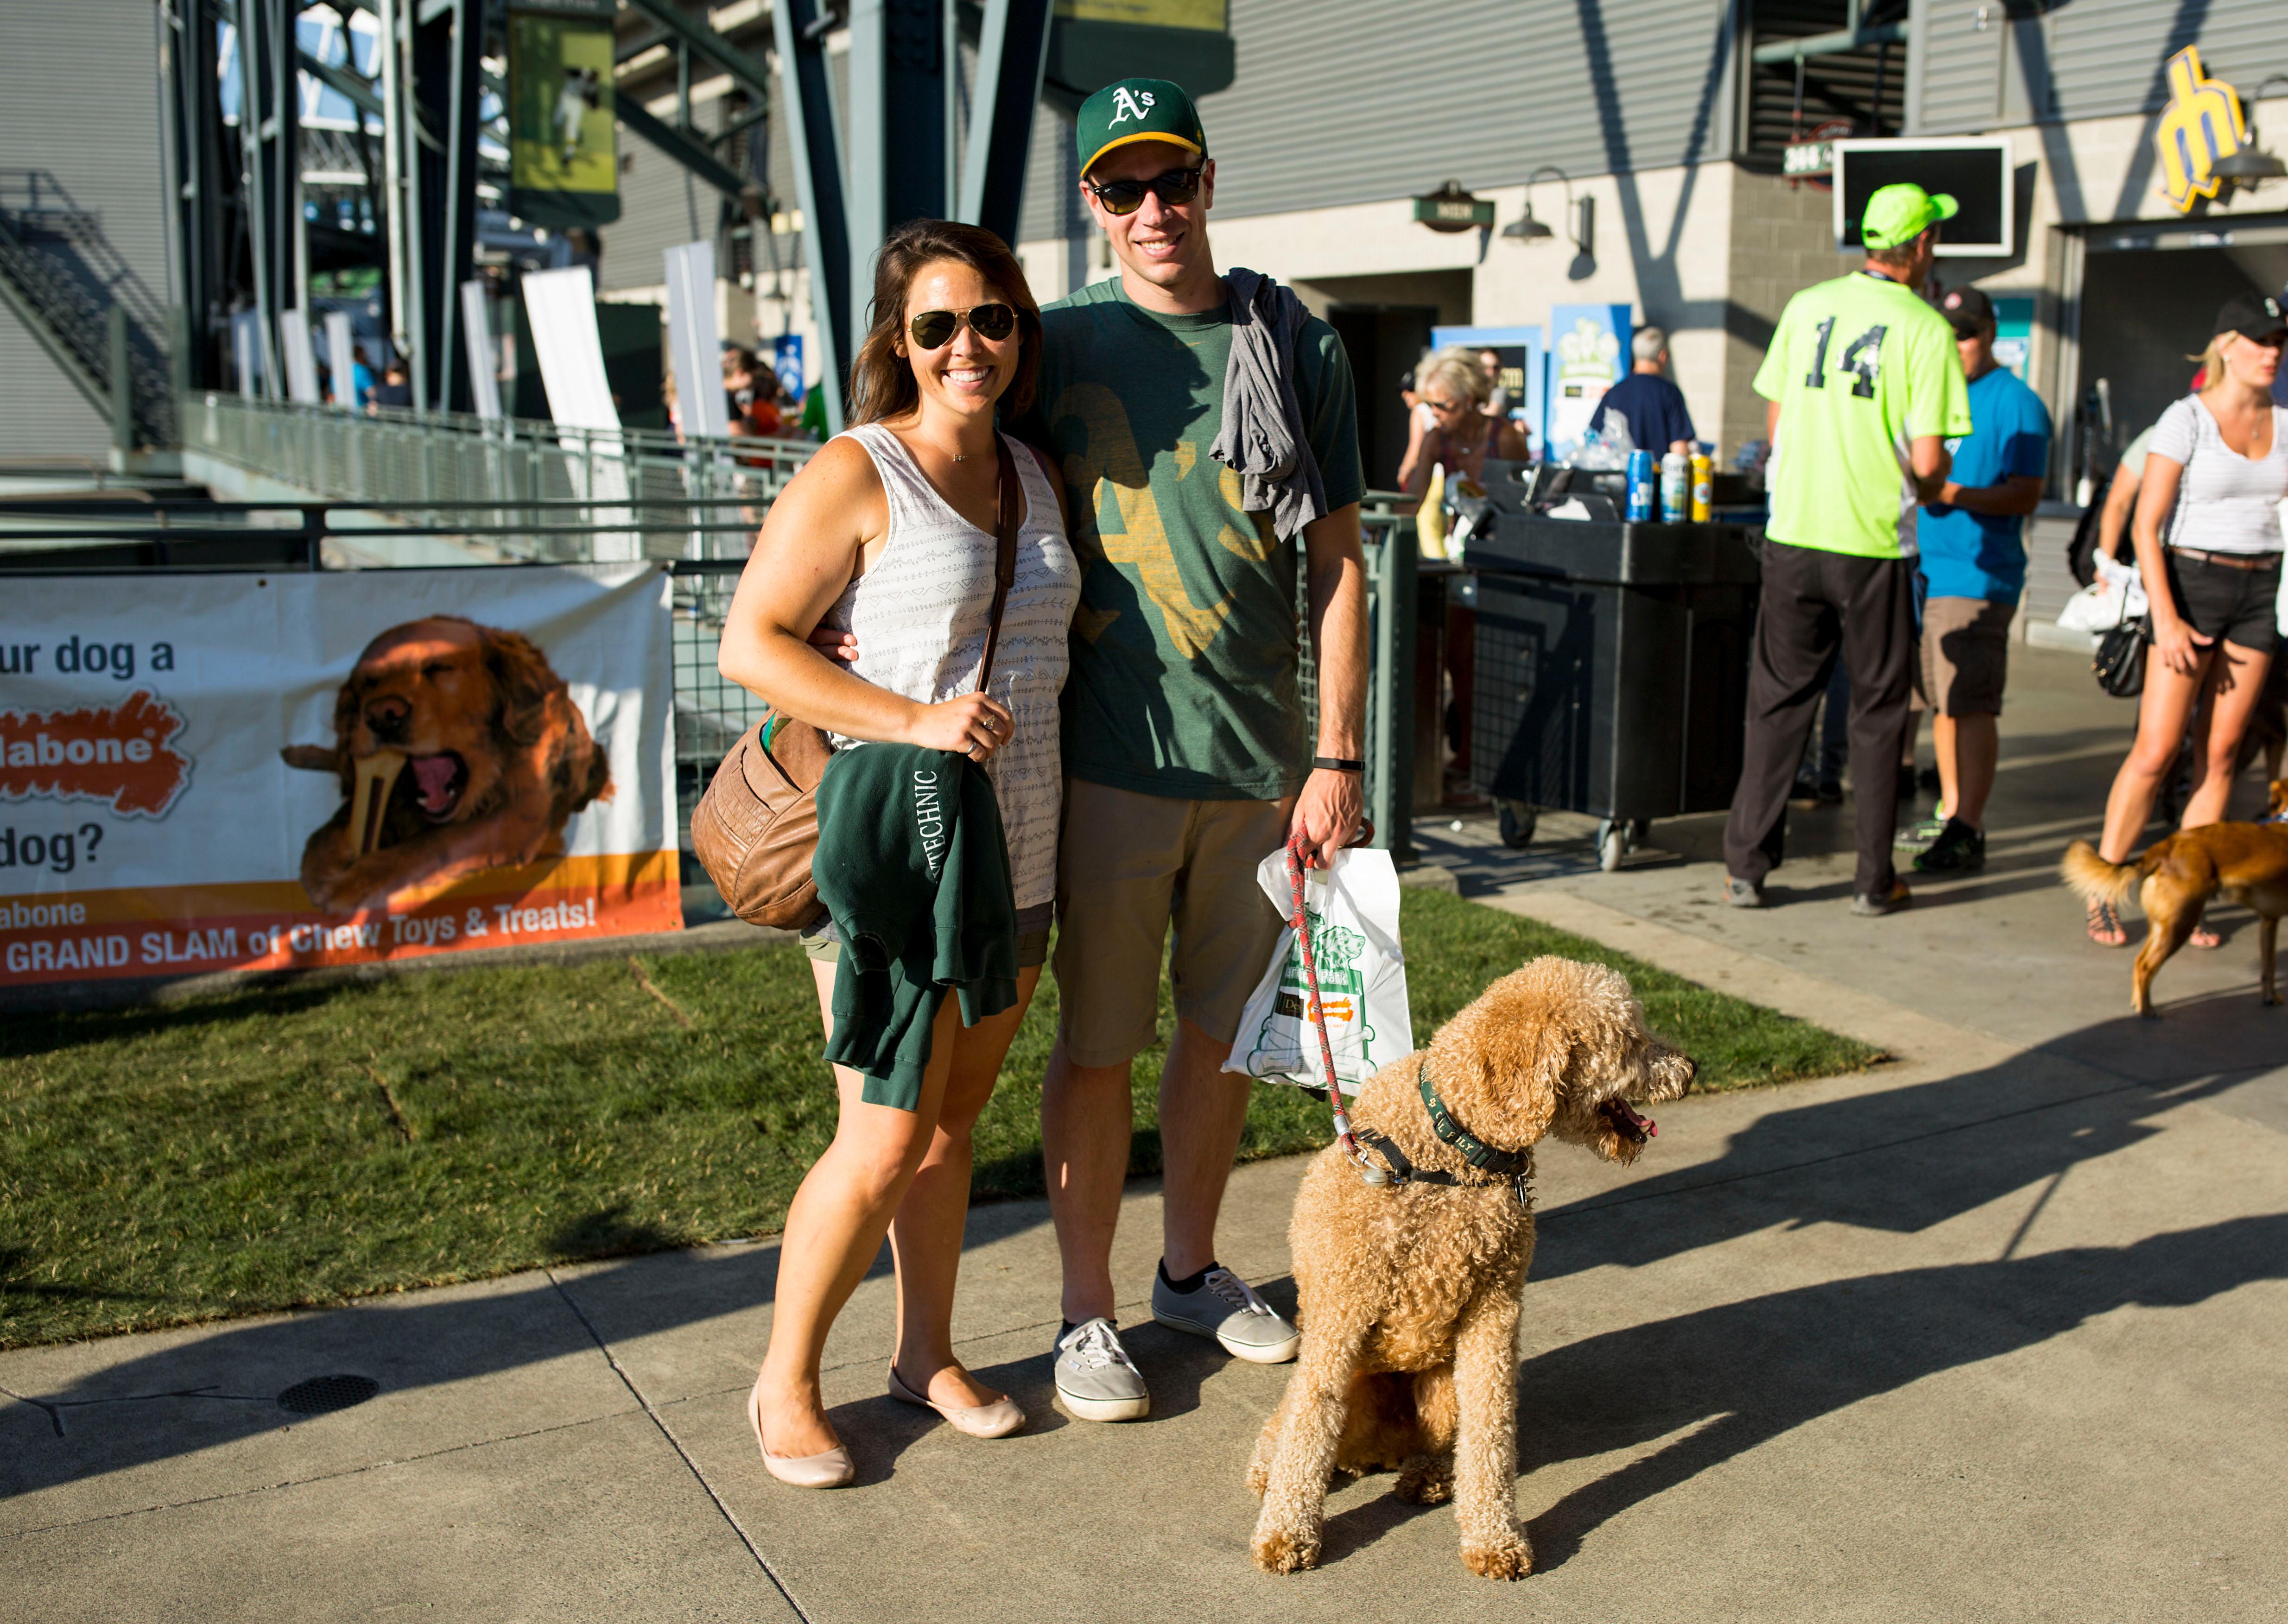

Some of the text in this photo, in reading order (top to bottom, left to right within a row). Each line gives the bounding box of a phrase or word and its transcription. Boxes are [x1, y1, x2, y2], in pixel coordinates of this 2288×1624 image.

[1108, 87, 1156, 130] A's
[1805, 316, 1888, 399] 14
[55, 634, 136, 682] dog
[150, 641, 175, 671] a
[0, 822, 104, 873] dog?
[6, 897, 596, 973] GRAND SLAM of Chew Toys & Treats!
[1319, 969, 1348, 986] Park
